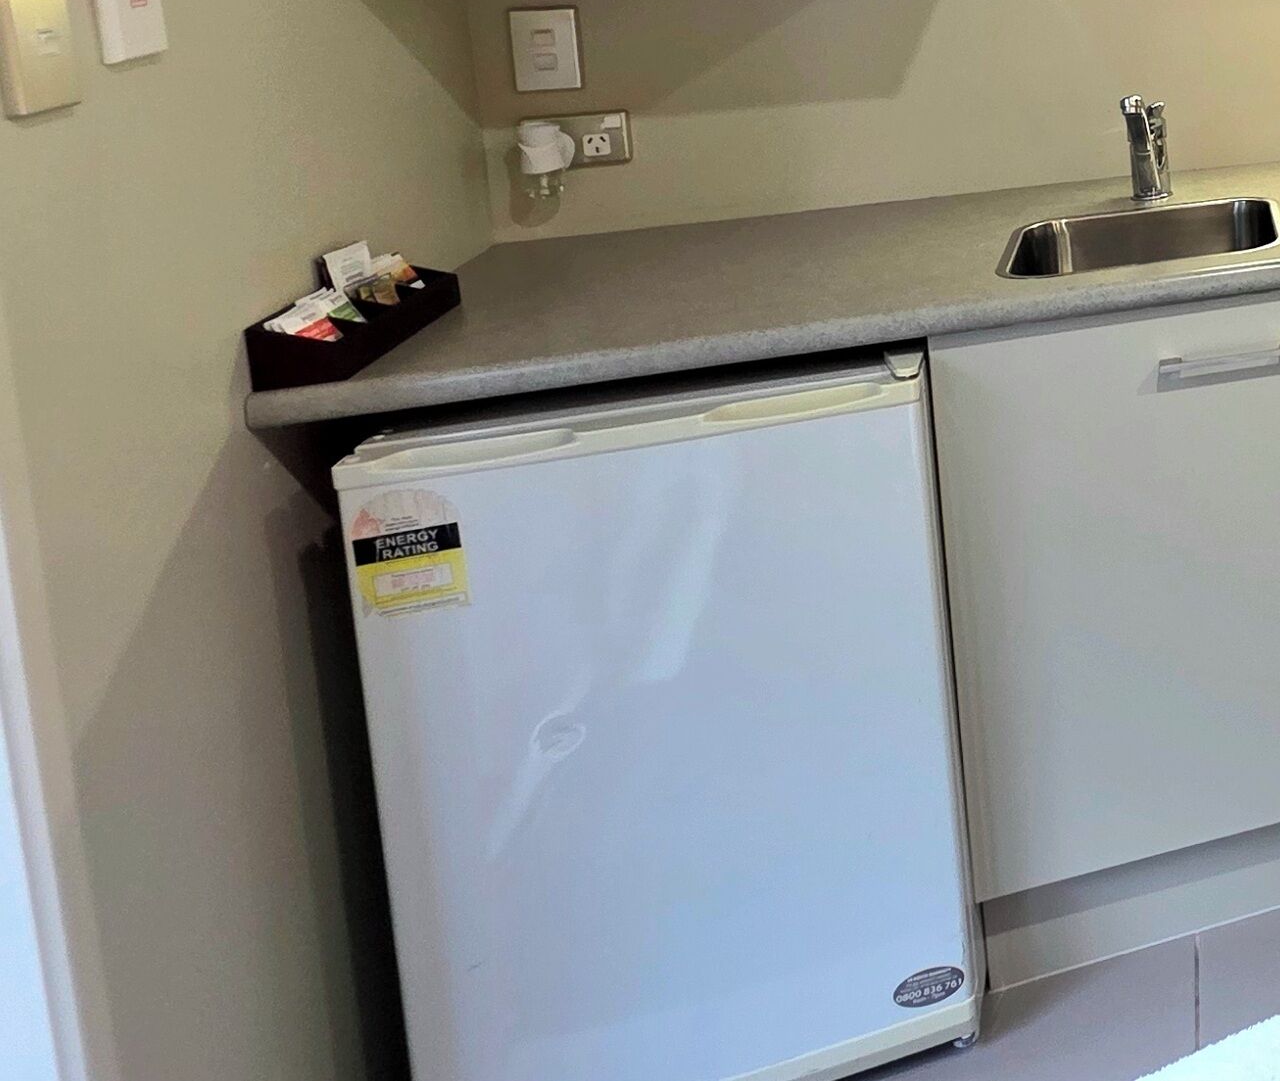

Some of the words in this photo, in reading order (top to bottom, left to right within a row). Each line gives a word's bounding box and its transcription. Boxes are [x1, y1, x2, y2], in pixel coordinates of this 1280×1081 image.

[376, 528, 438, 550] ENERGY
[382, 540, 439, 560] RATING
[895, 989, 921, 1003] 0800
